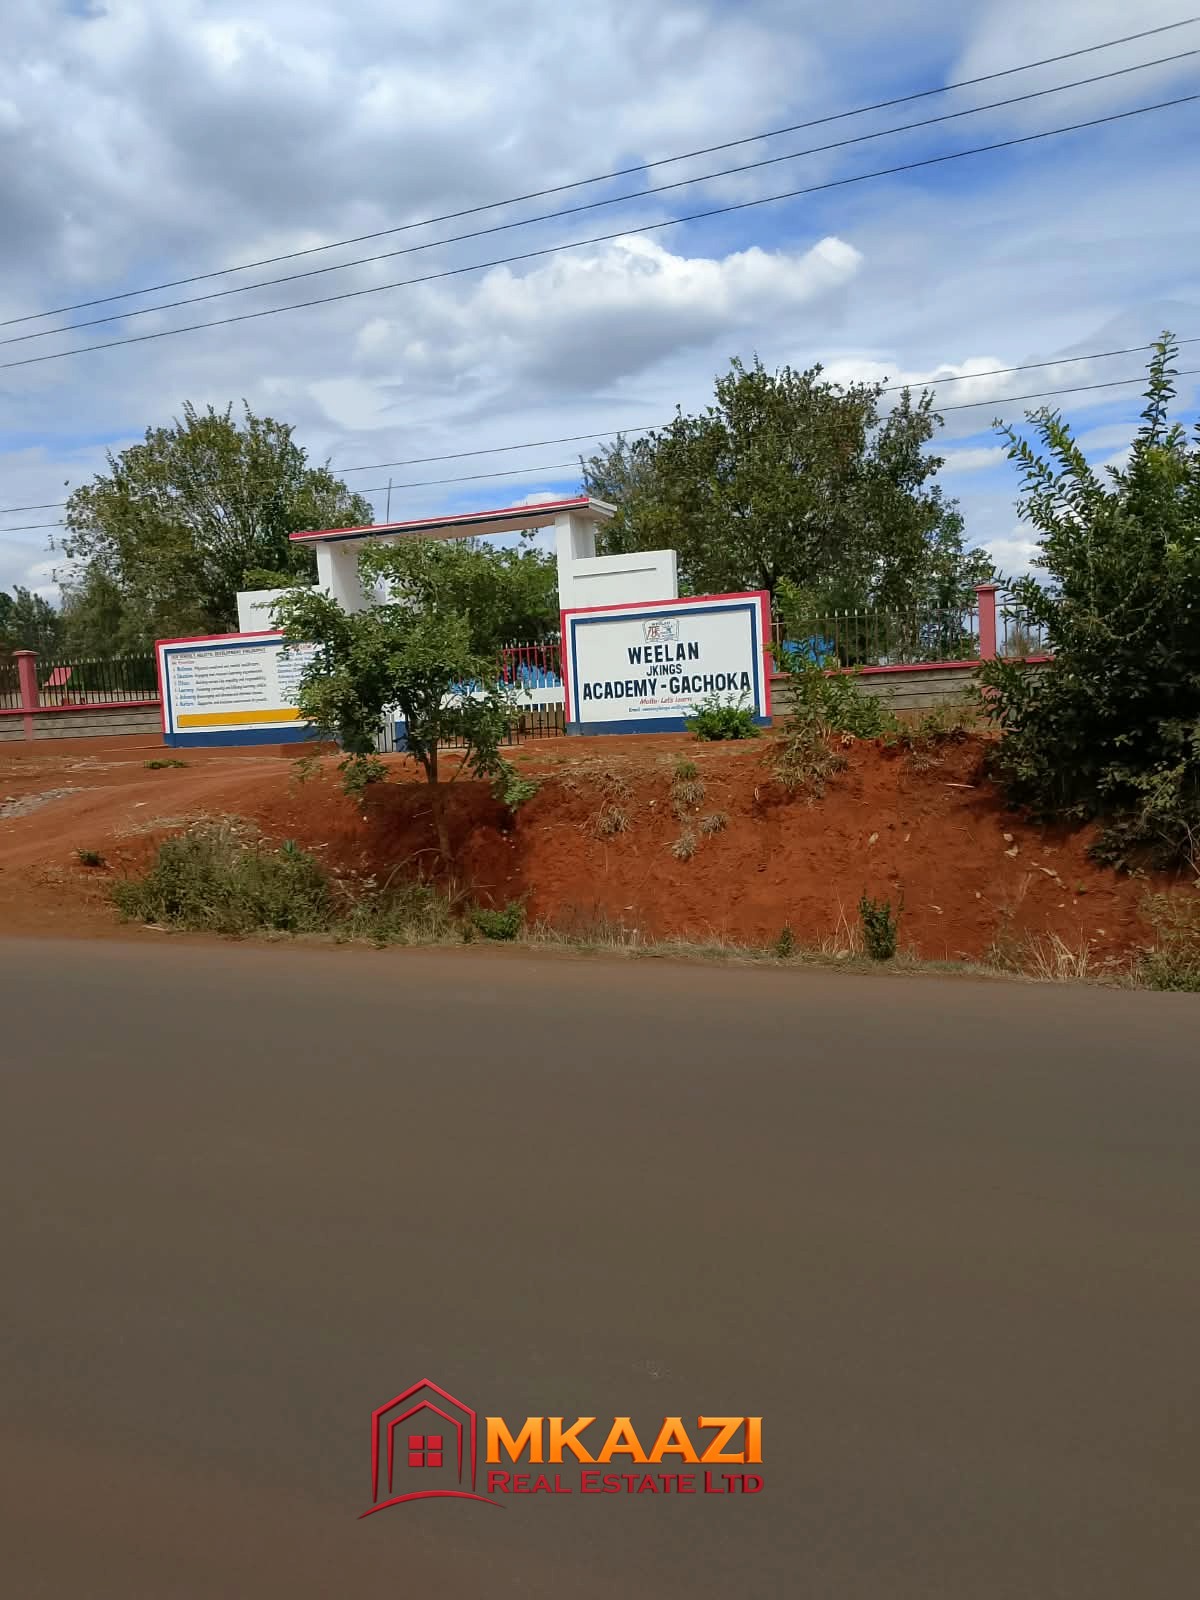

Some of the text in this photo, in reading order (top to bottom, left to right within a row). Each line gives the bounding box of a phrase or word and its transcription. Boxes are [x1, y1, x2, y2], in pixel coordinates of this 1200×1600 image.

[628, 641, 699, 664] WEELAN
[646, 663, 683, 677] JKINGS
[583, 678, 658, 700] ACADEMY
[669, 671, 751, 694] GACHOKA
